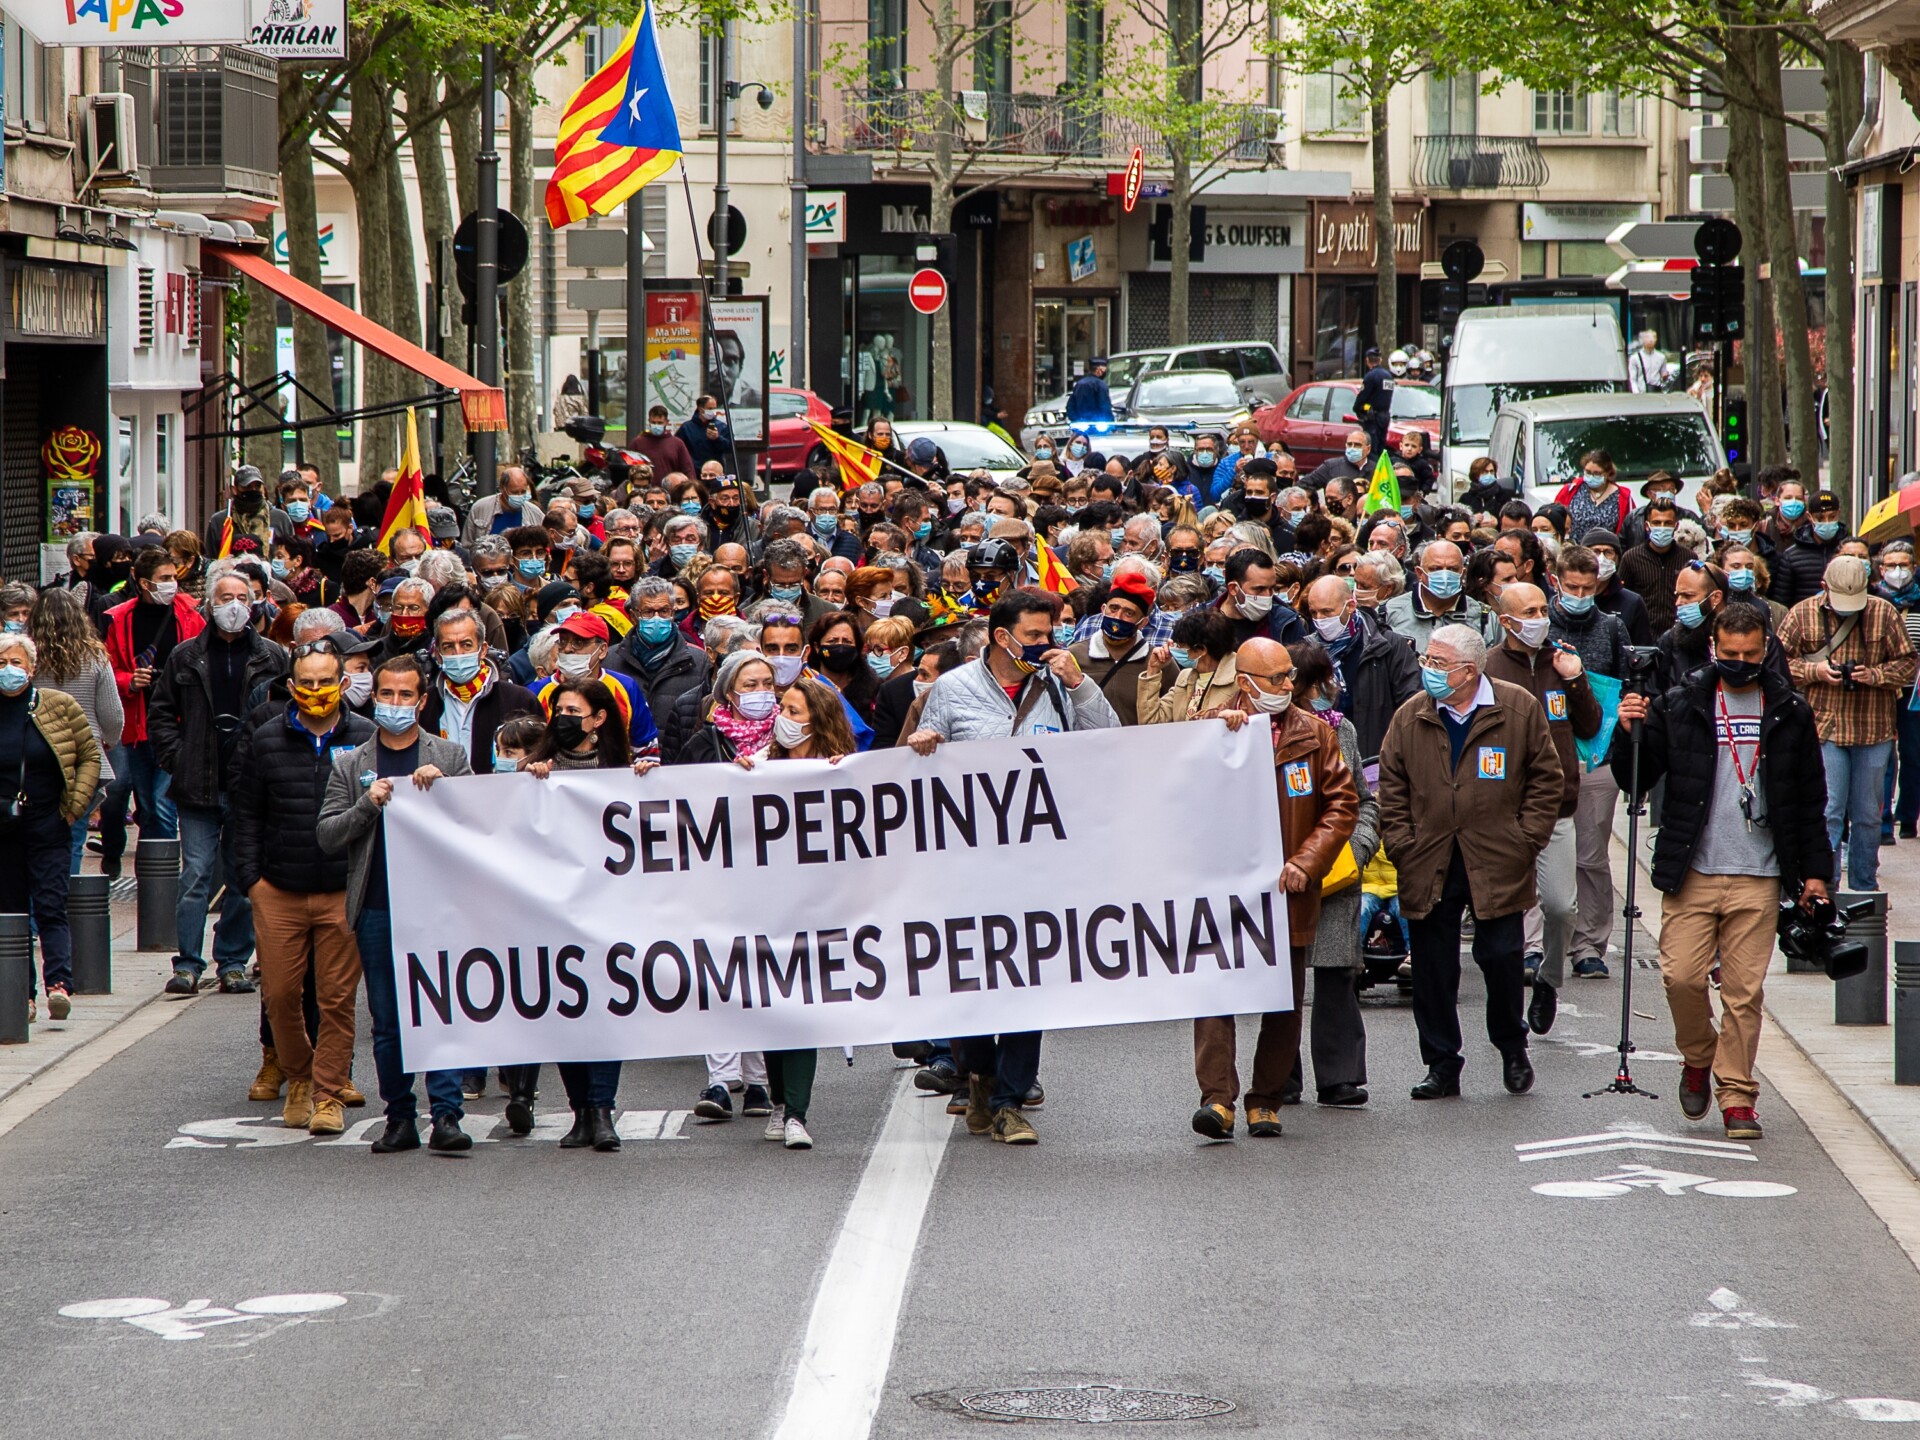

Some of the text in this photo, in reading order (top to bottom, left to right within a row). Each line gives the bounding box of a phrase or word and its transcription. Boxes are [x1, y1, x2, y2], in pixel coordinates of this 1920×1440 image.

[252, 26, 337, 45] CATALAN
[1127, 158, 1140, 199] TABAC
[1228, 224, 1291, 247] OLUFSEN
[1317, 213, 1335, 254] Le
[1333, 212, 1370, 266] petit
[655, 327, 691, 337] Ma Ville
[661, 337, 698, 345] Commerces
[1739, 725, 1760, 735] CANA
[602, 747, 1067, 876] SEM PERPINYÀ
[406, 891, 1278, 1027] NOUS SOMMES PERPIGNAN
